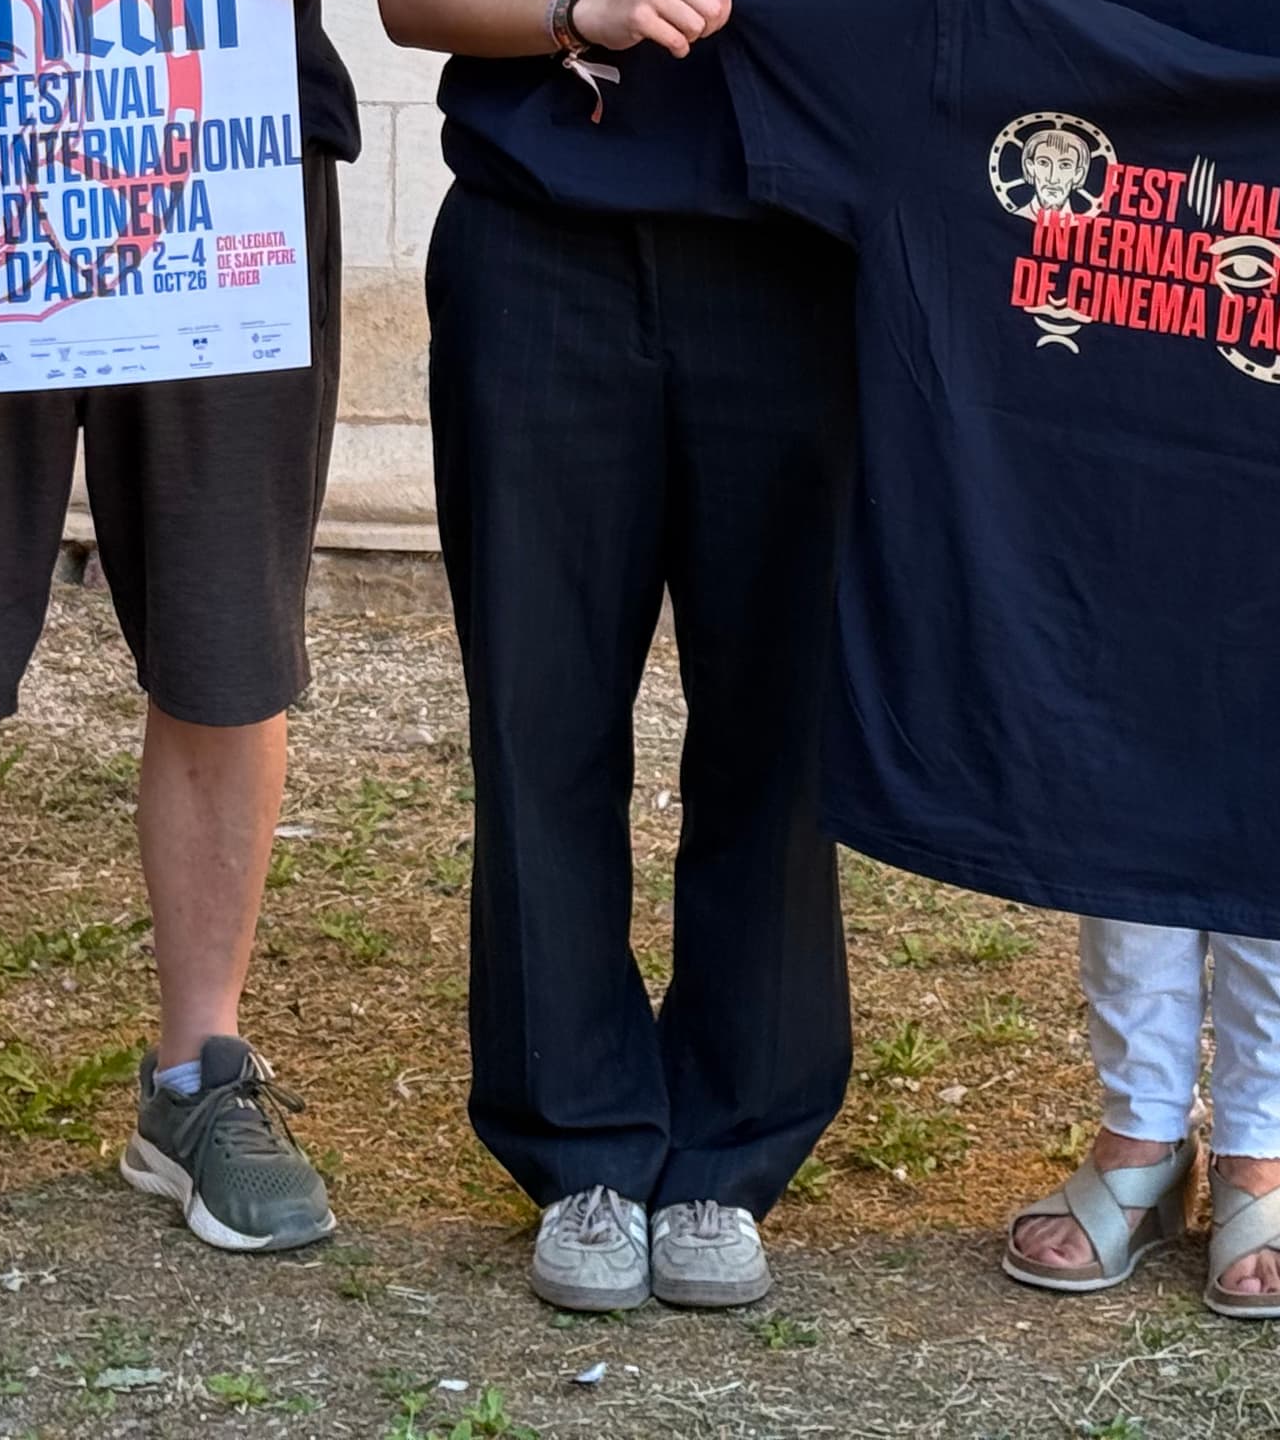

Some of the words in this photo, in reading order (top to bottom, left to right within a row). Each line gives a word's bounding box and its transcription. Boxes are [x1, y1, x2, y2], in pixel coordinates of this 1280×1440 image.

[0, 114, 302, 188] INTERNACIONAL
[2, 191, 51, 245] DE
[62, 180, 213, 242] CINEMA
[217, 253, 233, 270] DE
[234, 251, 264, 269] SANT
[267, 249, 297, 266] PERE
[1010, 256, 1061, 309] DE
[1065, 267, 1206, 339] CINEMA
